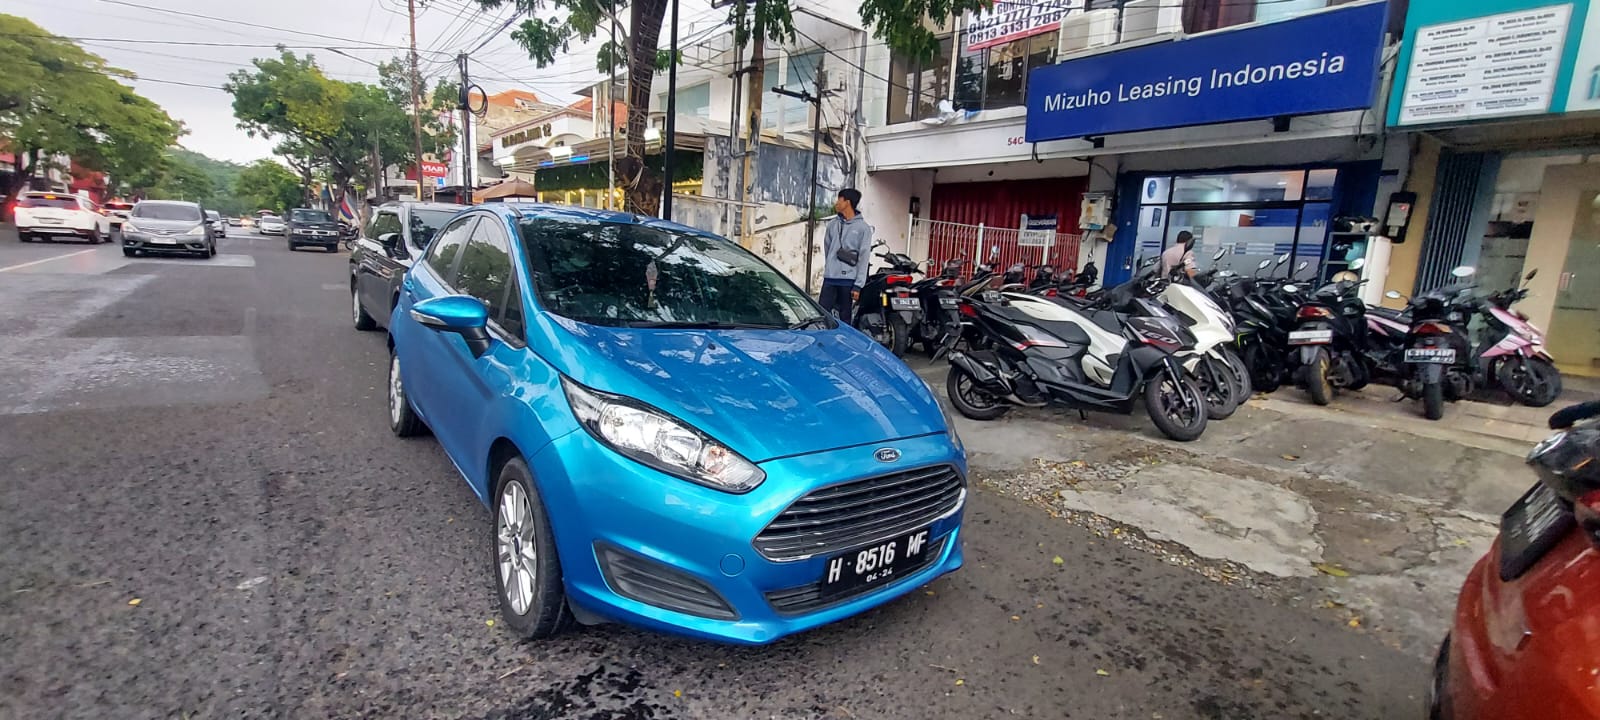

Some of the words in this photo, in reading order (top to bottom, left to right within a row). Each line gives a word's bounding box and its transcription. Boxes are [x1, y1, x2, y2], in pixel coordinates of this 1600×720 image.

[1004, 6, 1032, 23] 7777
[969, 28, 998, 44] 0813
[1000, 18, 1030, 35] 3131
[1044, 88, 1111, 113] Mizuho
[1117, 75, 1202, 103] Leasing
[1210, 53, 1345, 90] Indonesia
[1007, 136, 1024, 146] 54C
[1139, 328, 1178, 344] 160
[880, 450, 896, 460] Ford
[828, 557, 843, 584] H
[855, 541, 897, 574] 8516
[906, 530, 928, 558] MF
